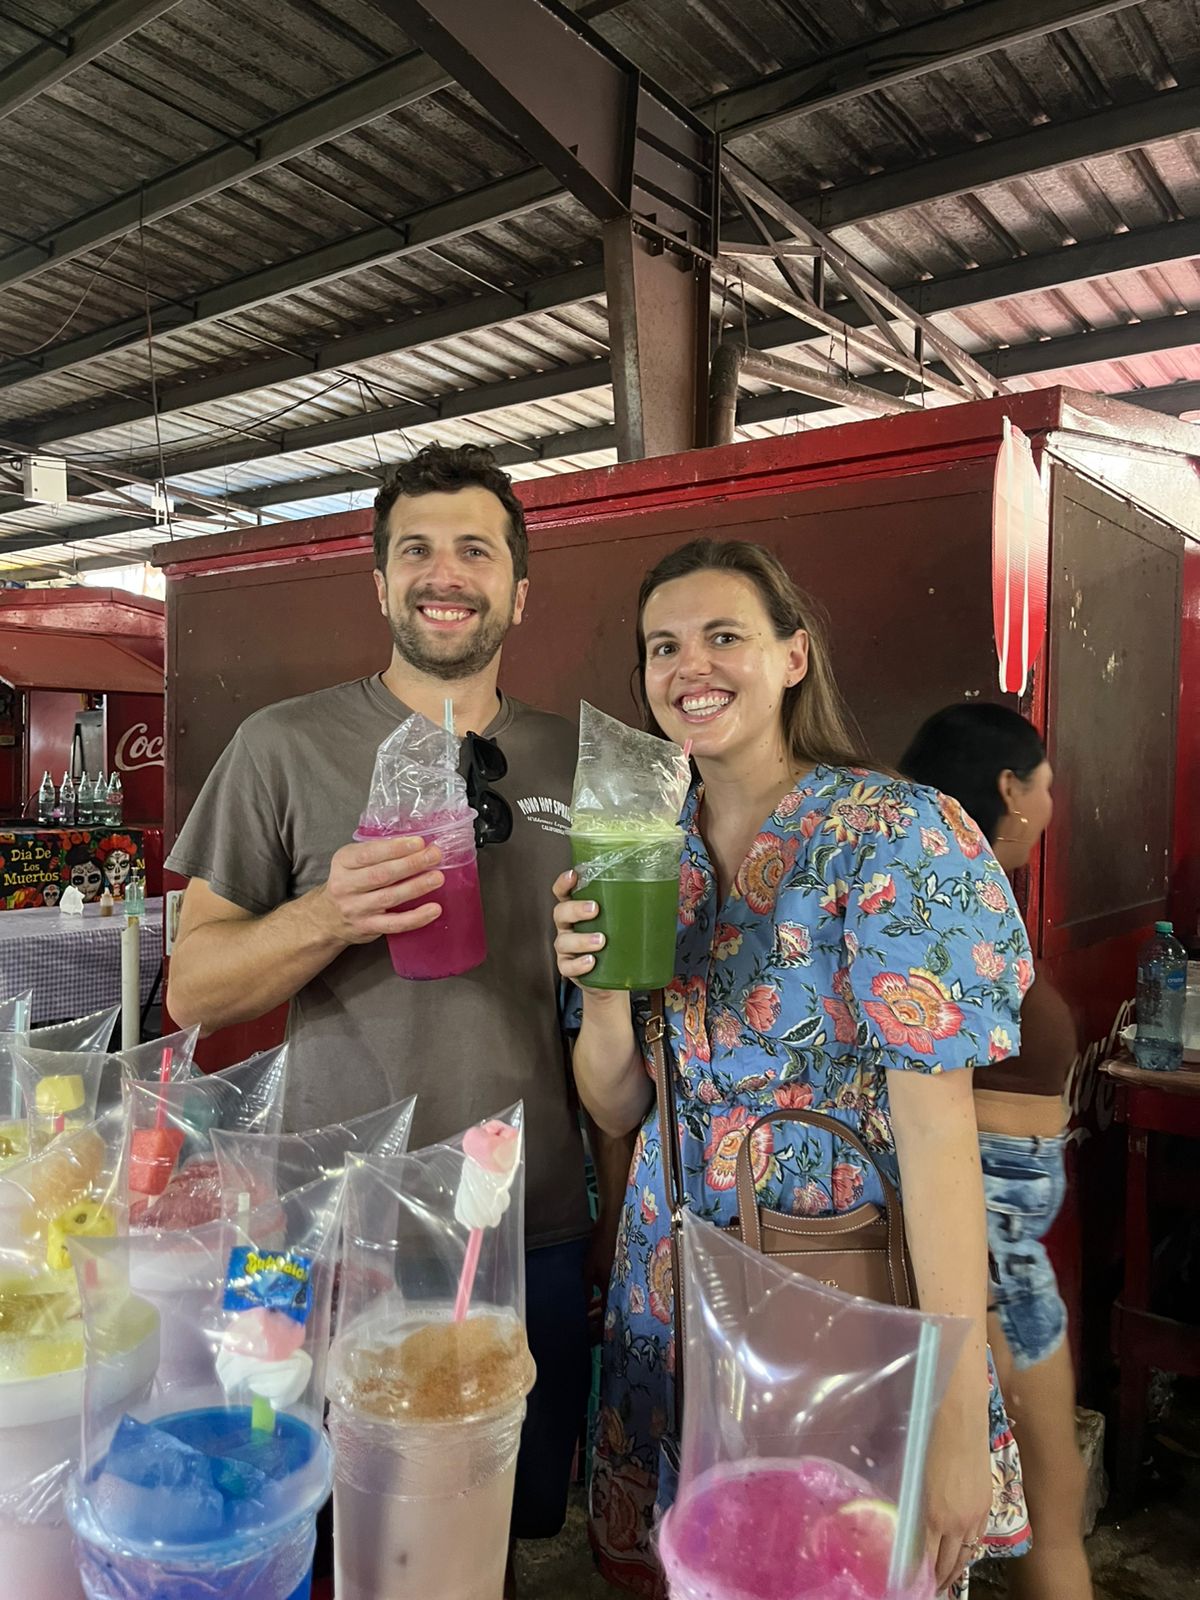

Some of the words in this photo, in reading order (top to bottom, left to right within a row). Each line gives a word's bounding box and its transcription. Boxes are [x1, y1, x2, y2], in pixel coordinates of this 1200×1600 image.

[115, 723, 165, 771] Coc
[11, 849, 32, 861] Dia
[35, 848, 51, 859] De
[23, 863, 40, 871] Los
[4, 870, 59, 886] Muertos
